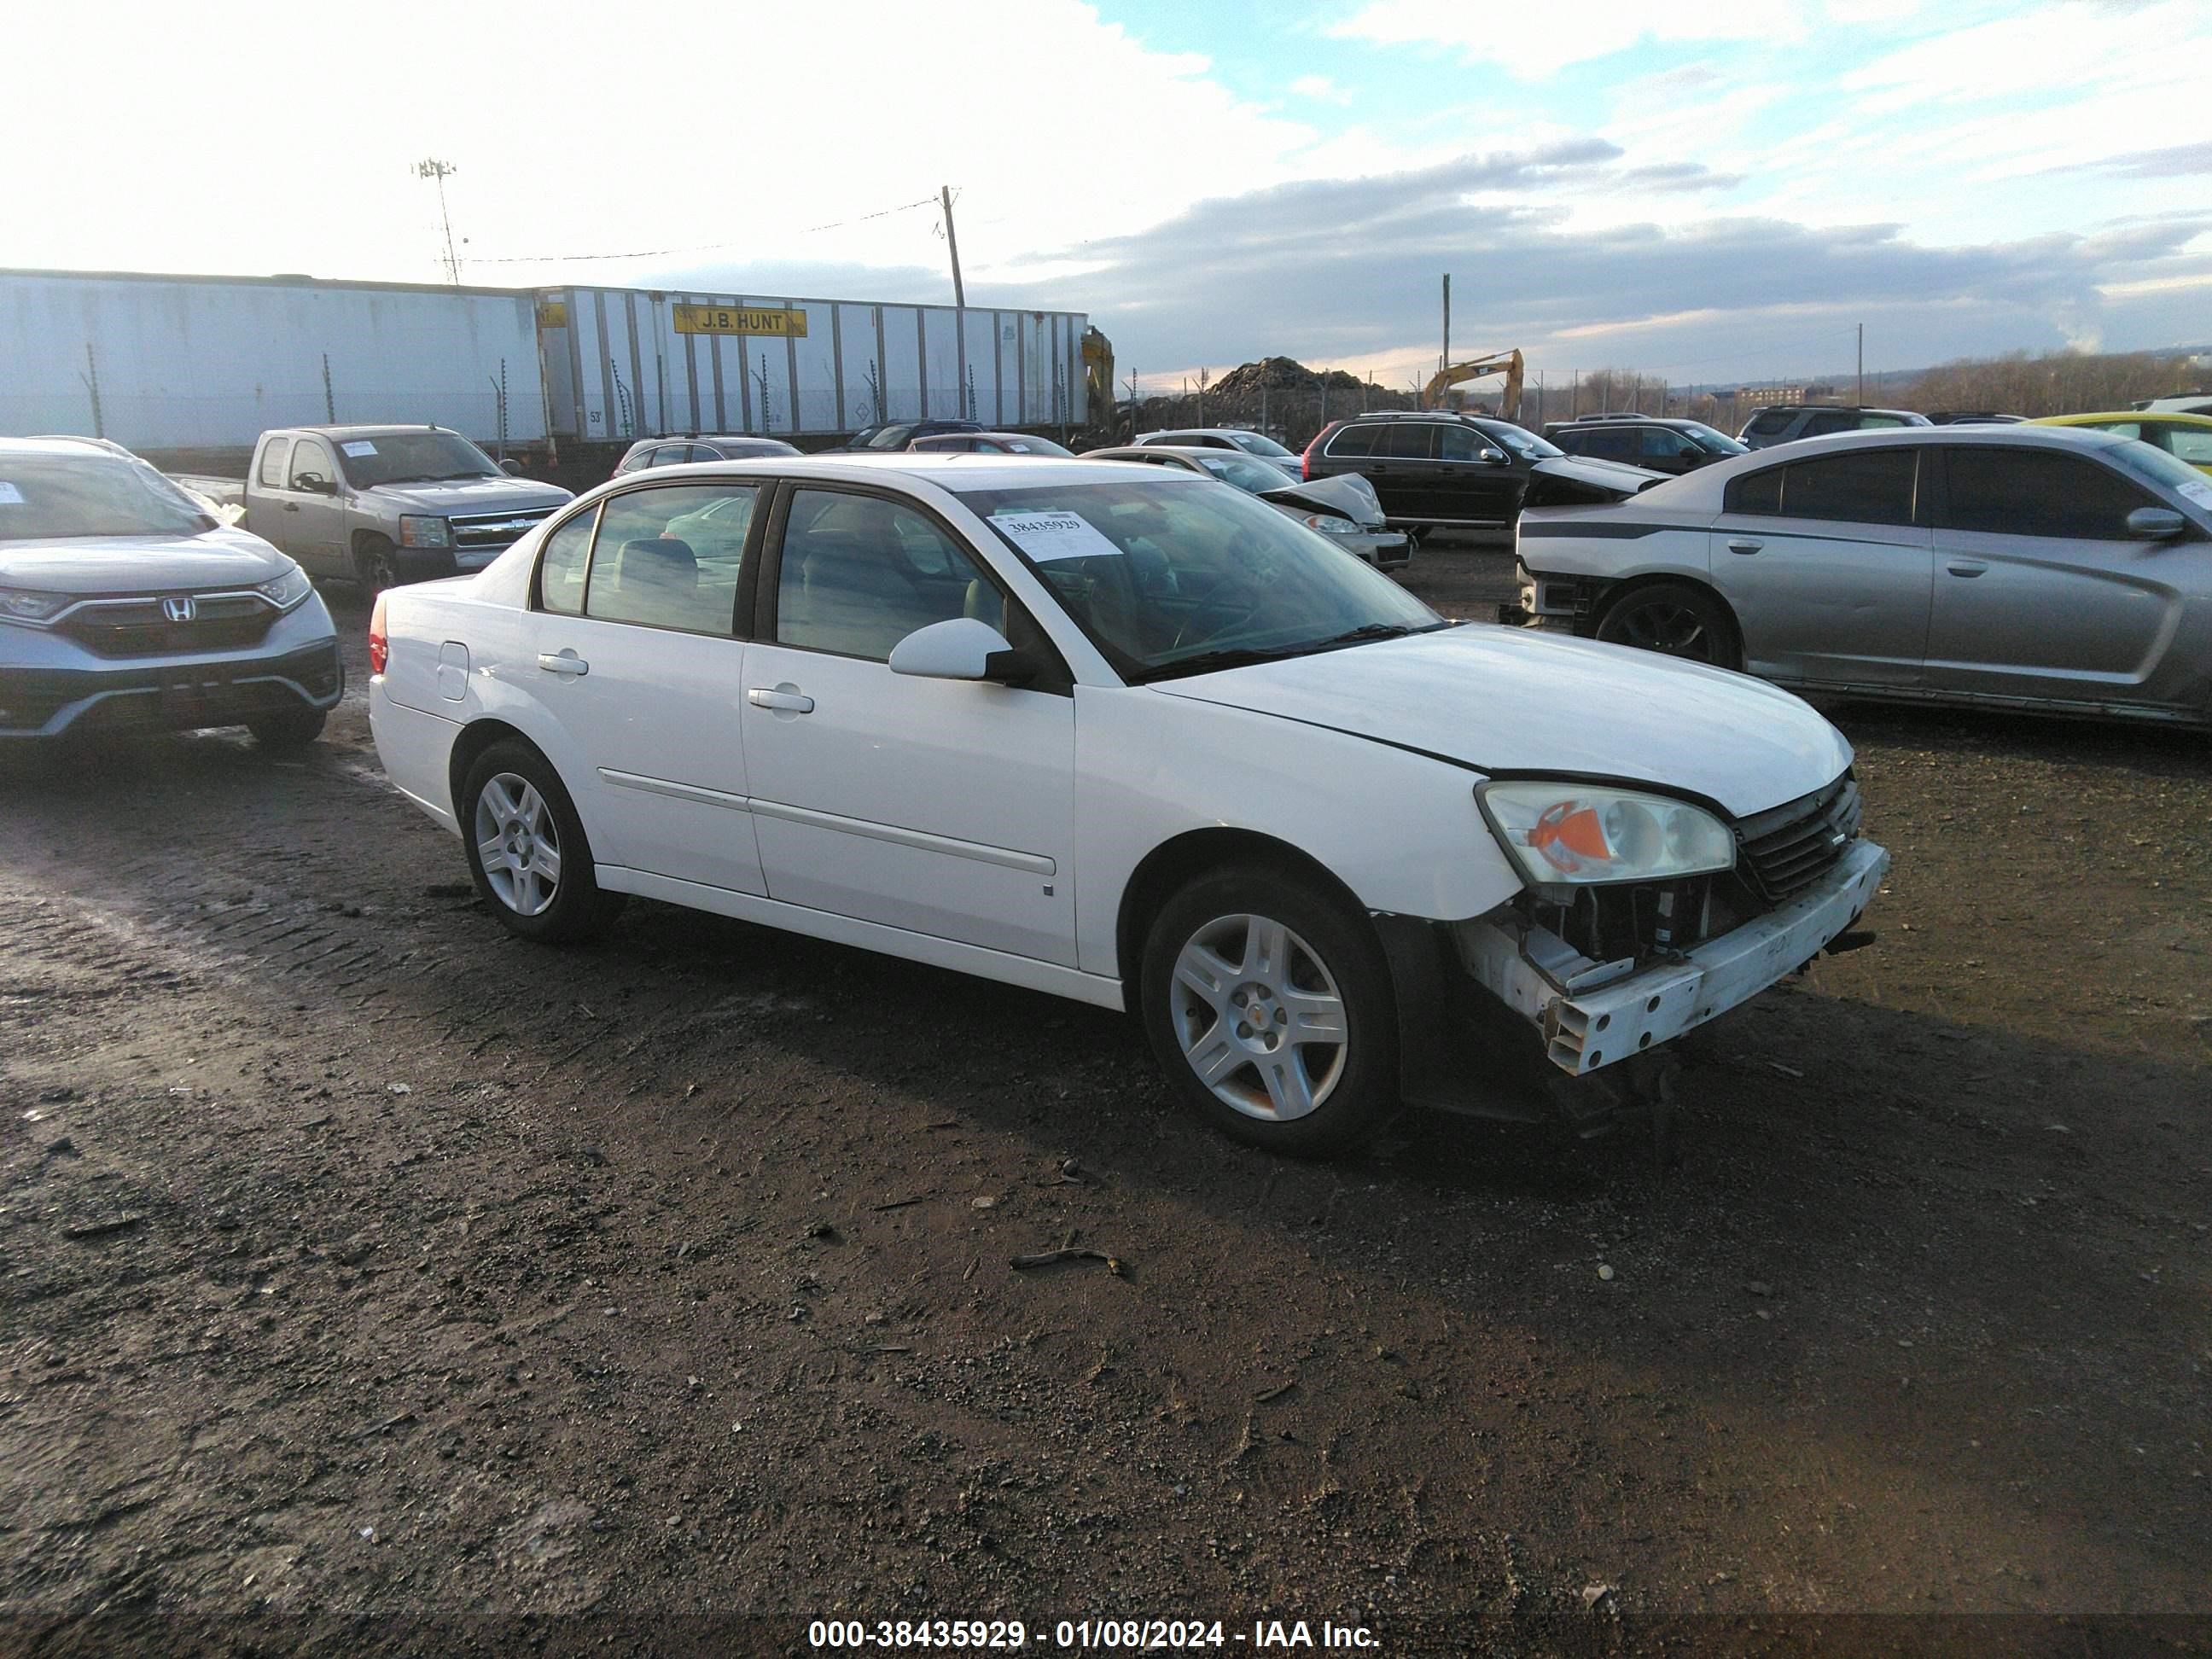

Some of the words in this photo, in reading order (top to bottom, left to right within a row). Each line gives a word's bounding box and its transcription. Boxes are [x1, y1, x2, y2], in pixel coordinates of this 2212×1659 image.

[702, 312, 734, 329] J.B.
[737, 313, 783, 330] HUNT
[1008, 520, 1080, 533] 38435929
